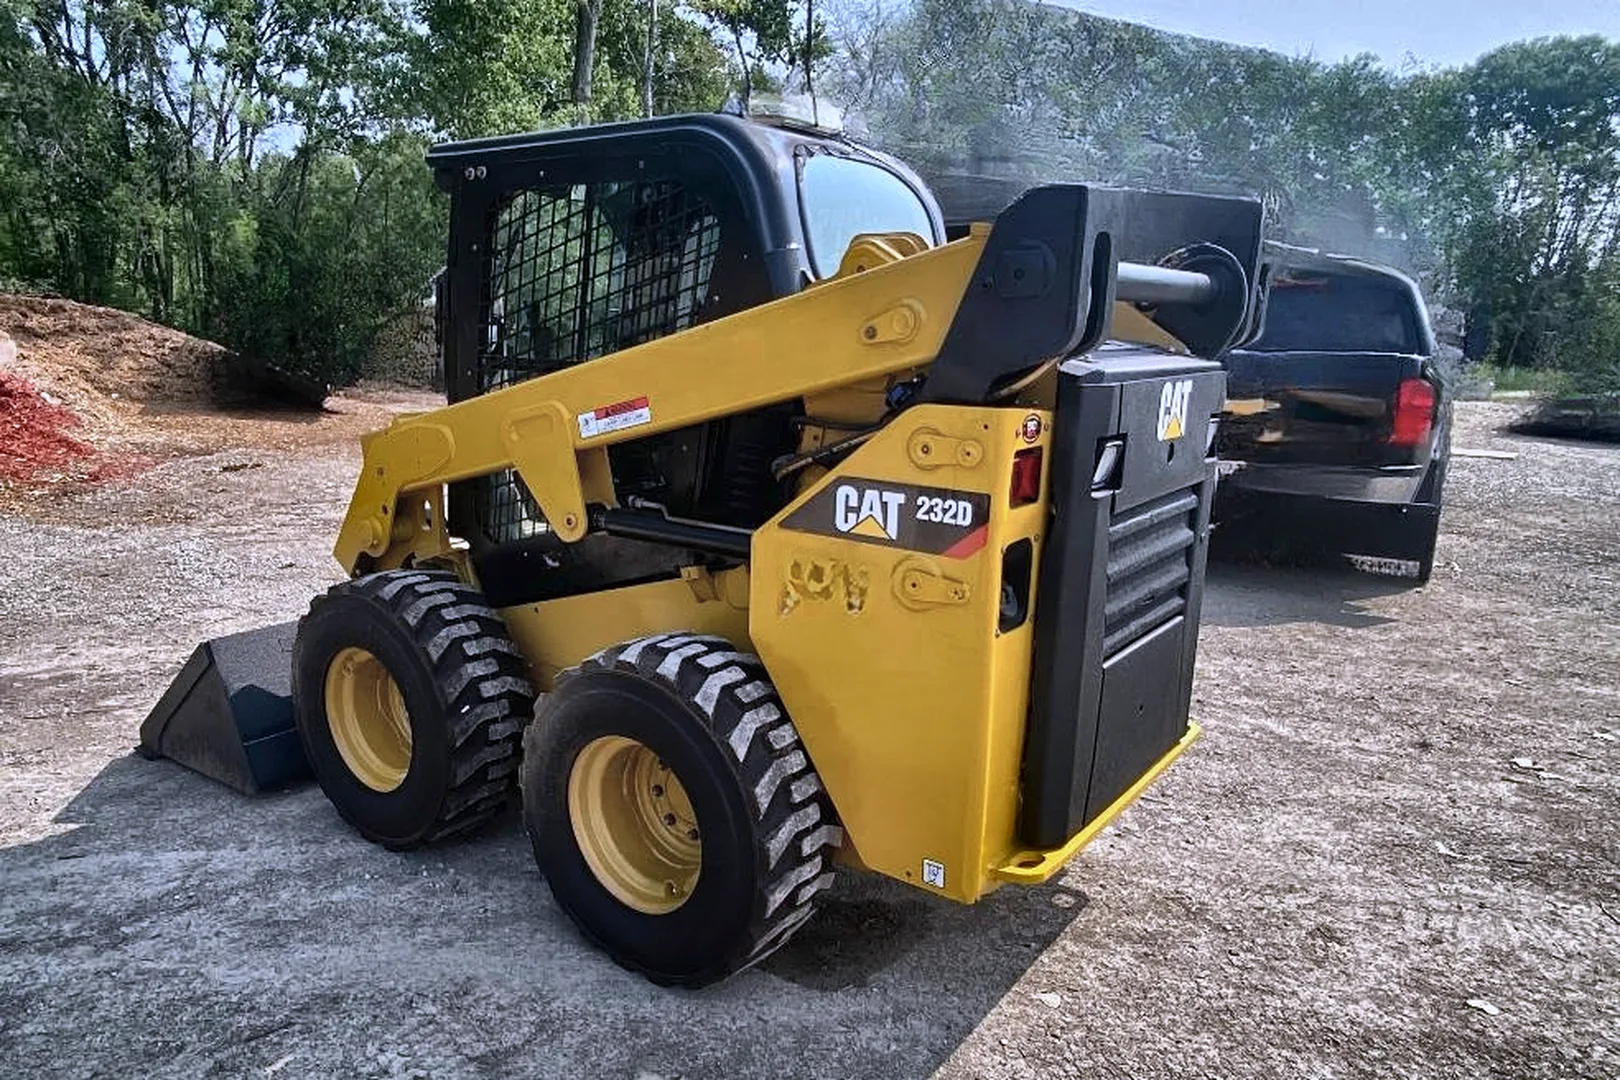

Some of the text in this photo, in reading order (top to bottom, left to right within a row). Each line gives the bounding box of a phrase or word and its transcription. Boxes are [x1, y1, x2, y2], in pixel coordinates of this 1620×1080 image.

[1157, 380, 1193, 441] CAT
[835, 485, 972, 540] CAT 232D
